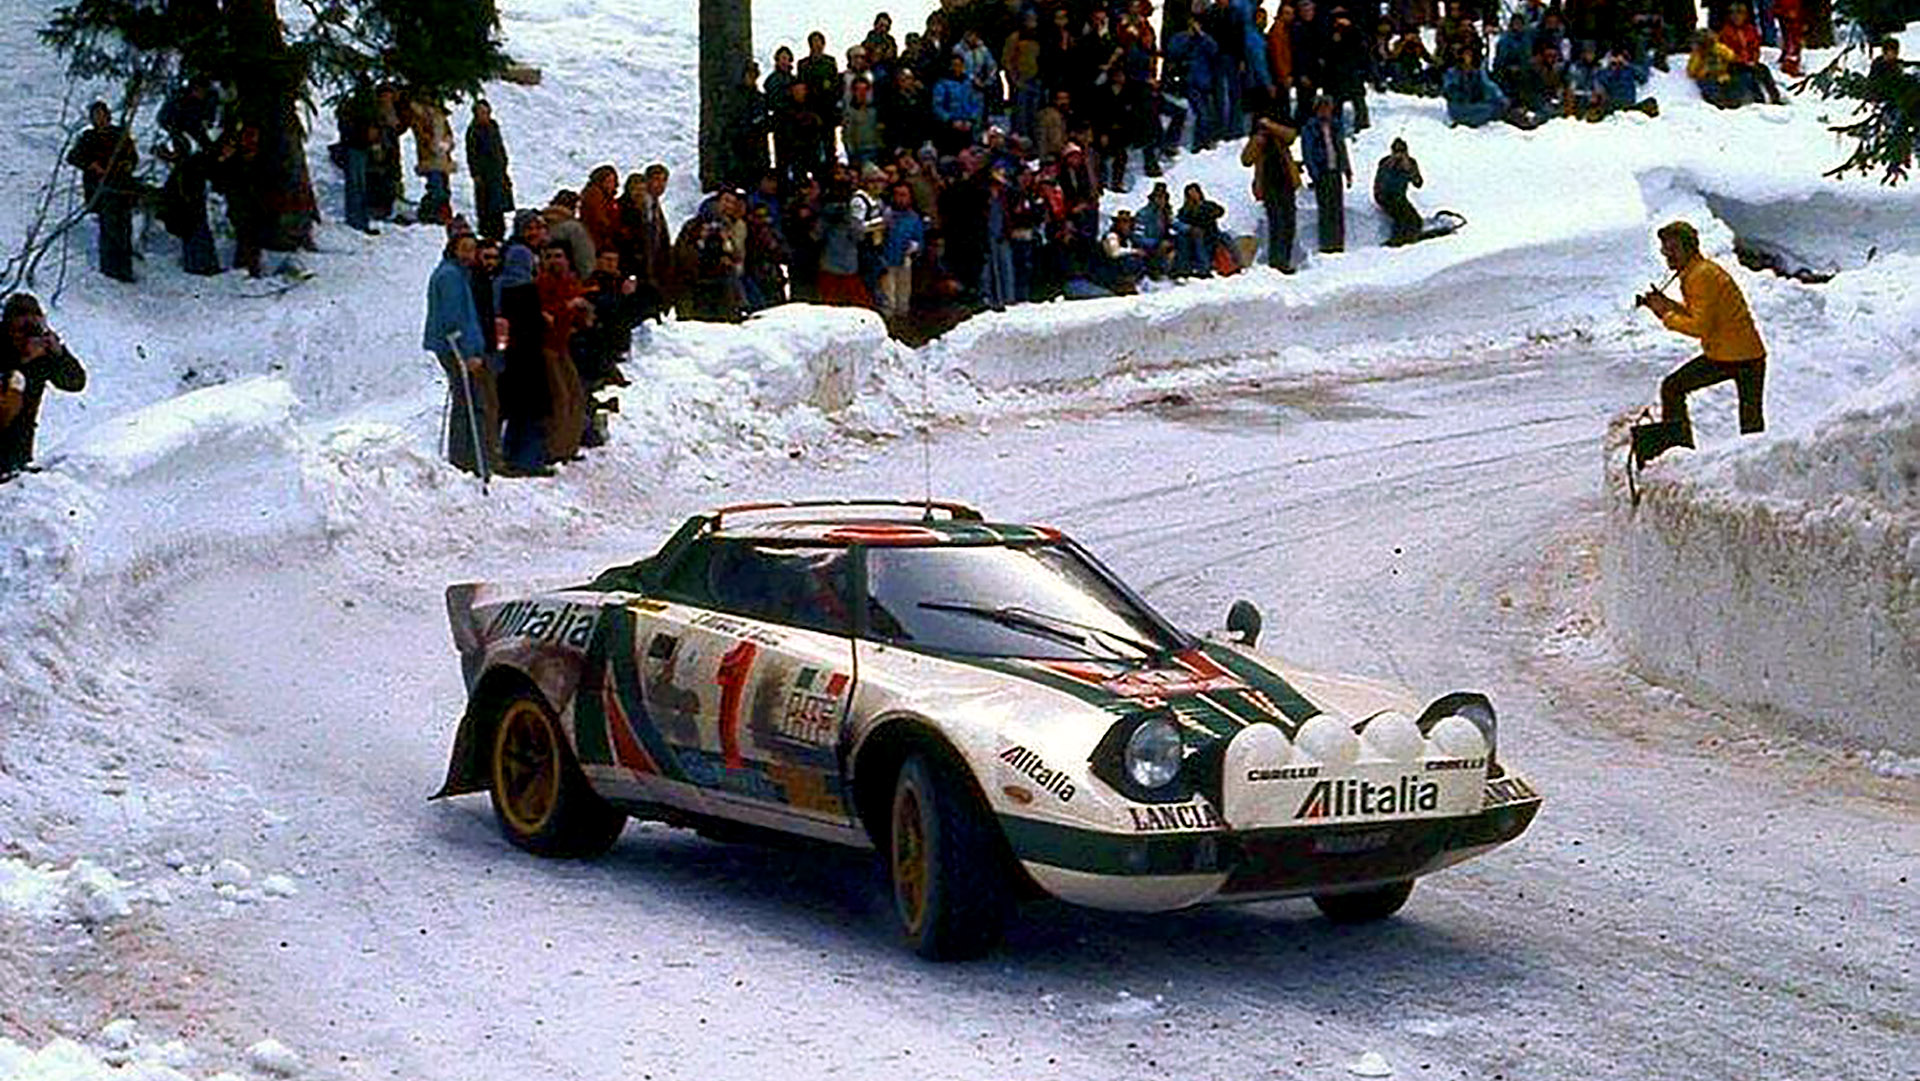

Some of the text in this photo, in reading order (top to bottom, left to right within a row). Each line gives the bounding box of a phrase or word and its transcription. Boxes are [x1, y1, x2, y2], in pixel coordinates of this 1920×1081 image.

[486, 601, 595, 646] Alitalia
[717, 640, 757, 768] 1
[1000, 746, 1076, 802] Alitalia
[1129, 805, 1222, 831] LANCIA
[1293, 776, 1438, 819] Alitalia
